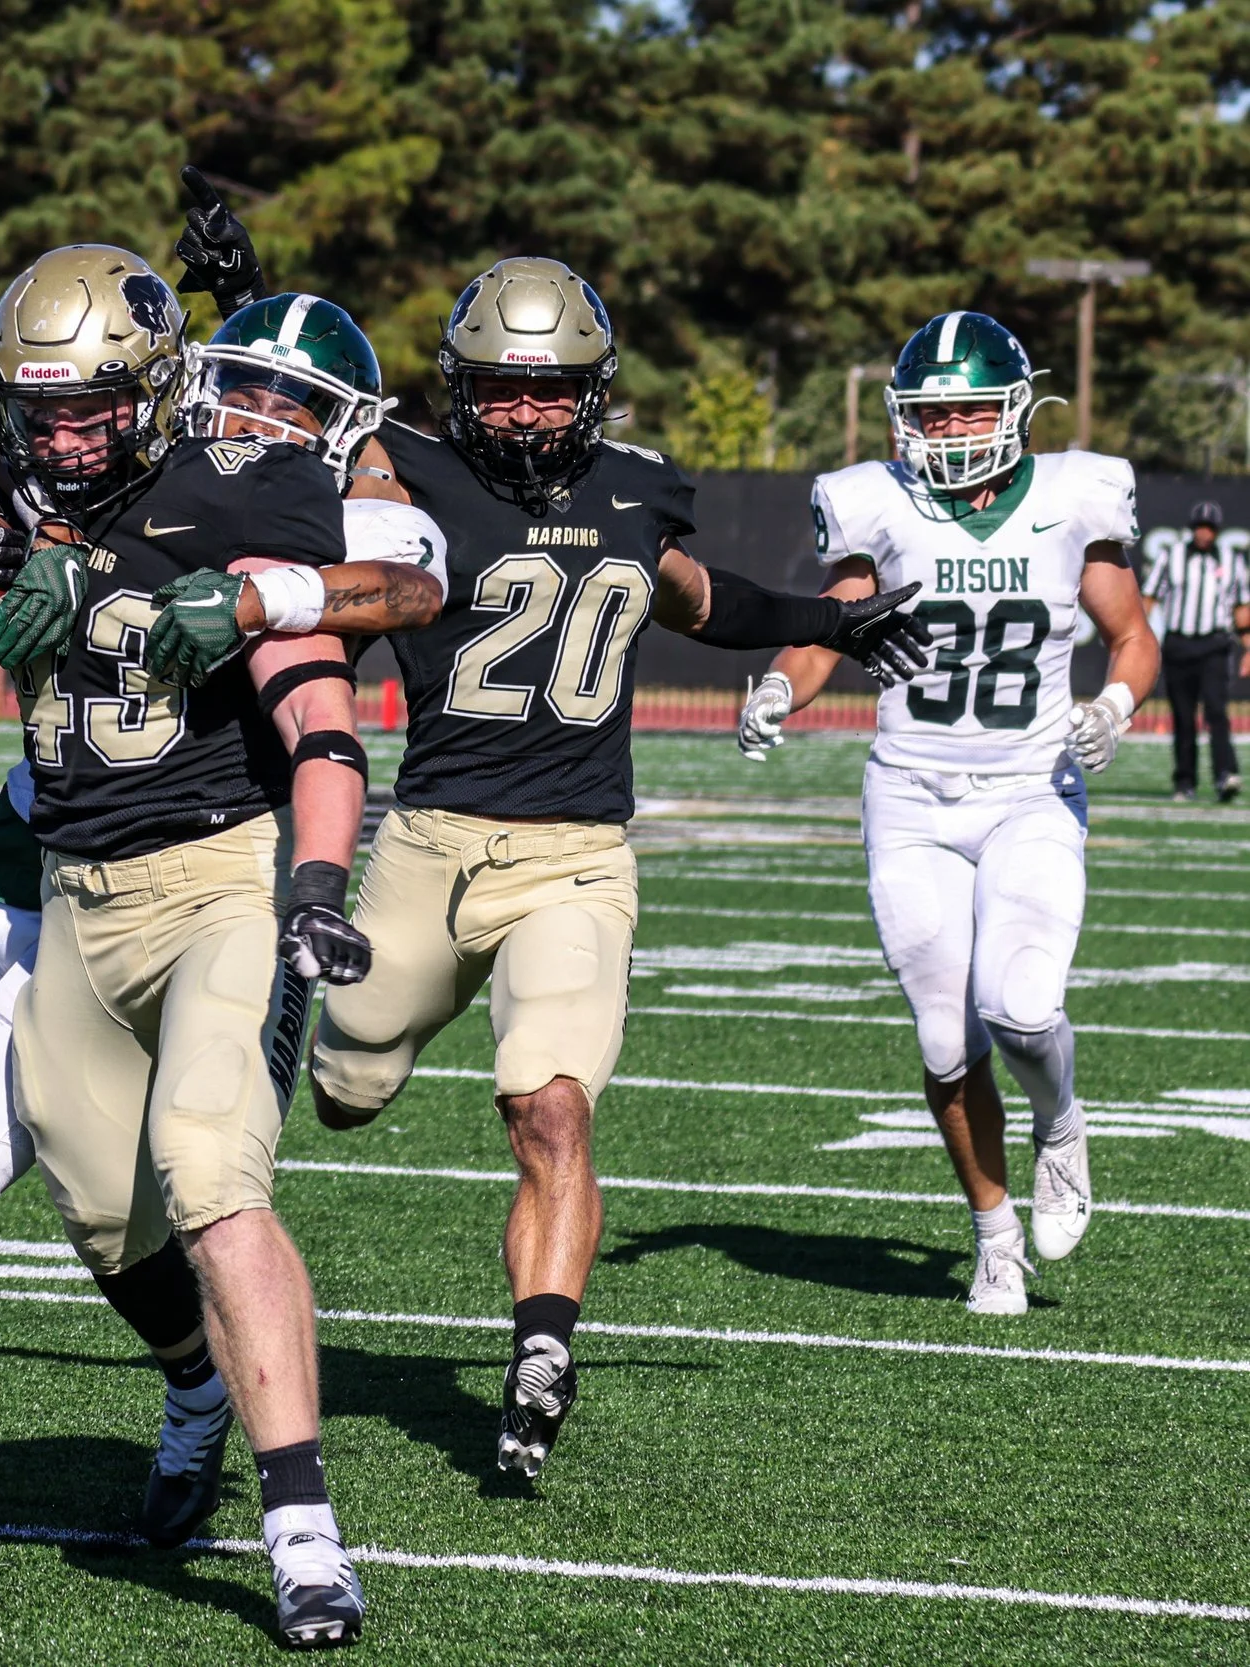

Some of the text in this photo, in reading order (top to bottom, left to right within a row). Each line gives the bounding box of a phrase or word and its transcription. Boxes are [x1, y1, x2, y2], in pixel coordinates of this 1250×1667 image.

[21, 367, 70, 379] Riddell
[526, 526, 599, 547] HARDING
[935, 557, 1030, 594] BISON
[442, 552, 654, 727] 20
[905, 599, 1051, 730] 38
[210, 813, 226, 825] M
[269, 960, 308, 1102] HARDIN
